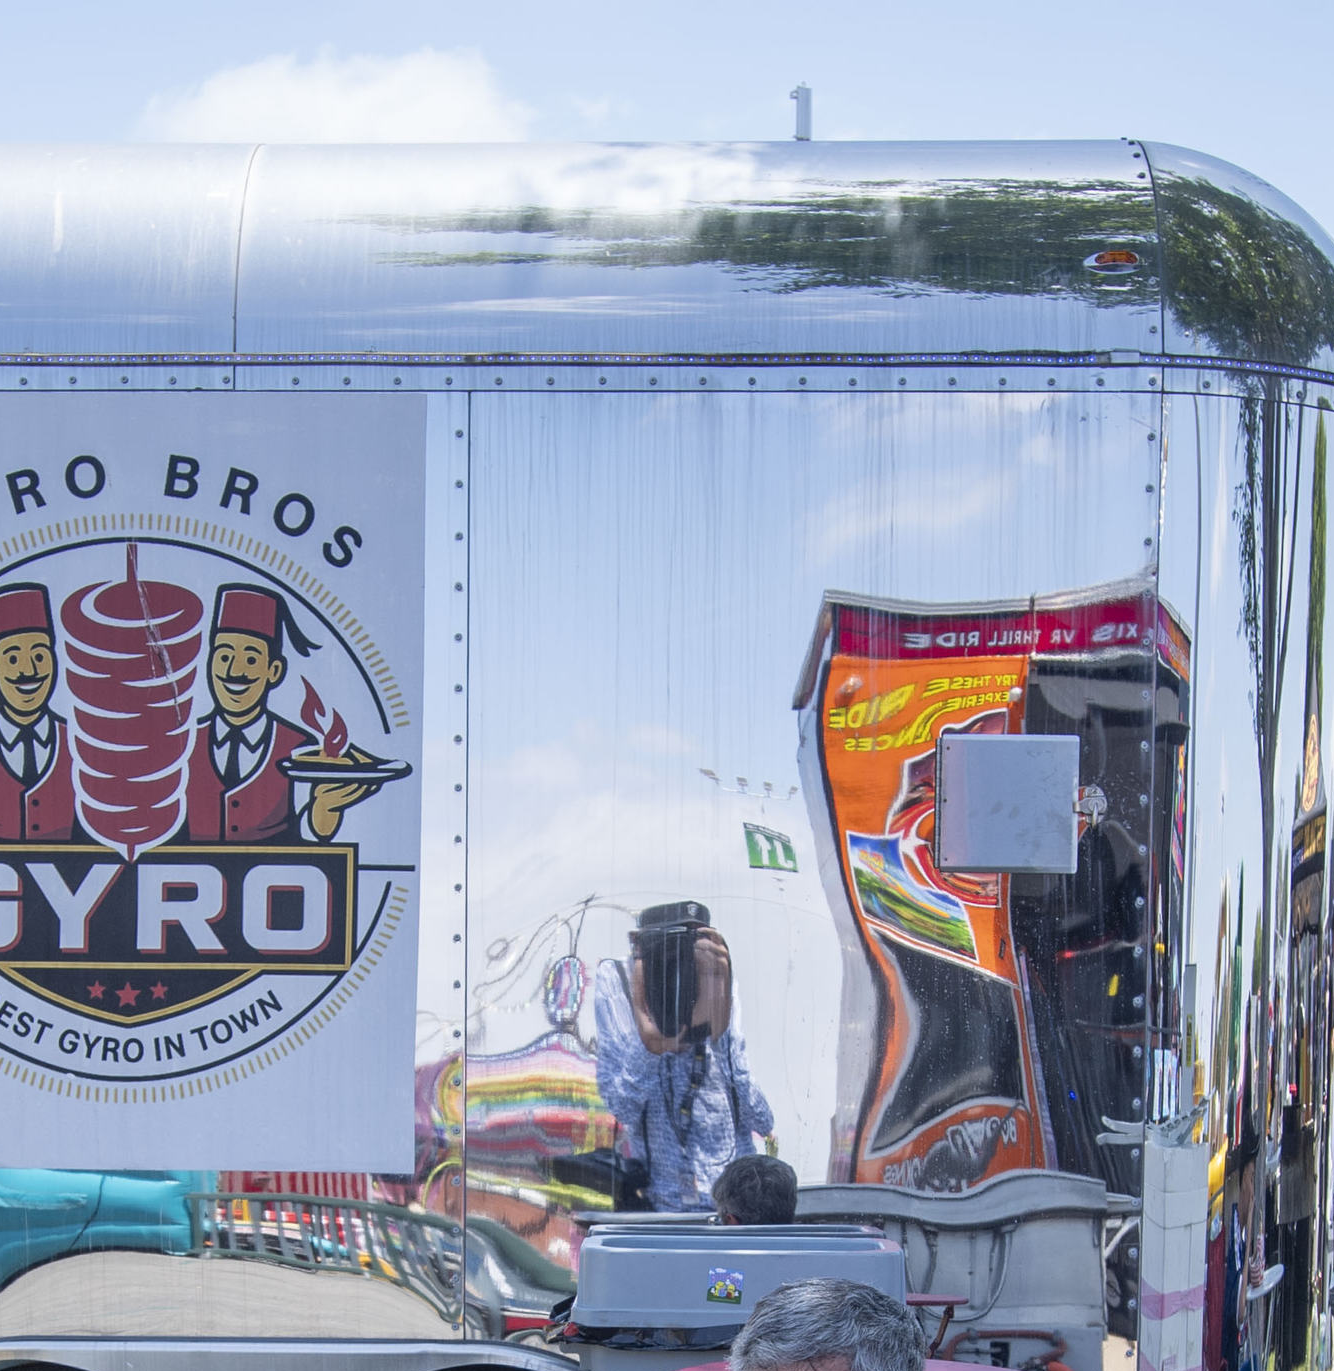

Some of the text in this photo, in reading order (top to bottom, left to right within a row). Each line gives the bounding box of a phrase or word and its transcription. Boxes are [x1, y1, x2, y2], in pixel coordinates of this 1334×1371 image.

[163, 454, 363, 568] BROS
[57, 1028, 146, 1063] GYRO
[154, 1033, 187, 1063] IN
[189, 989, 285, 1052] TOWN
